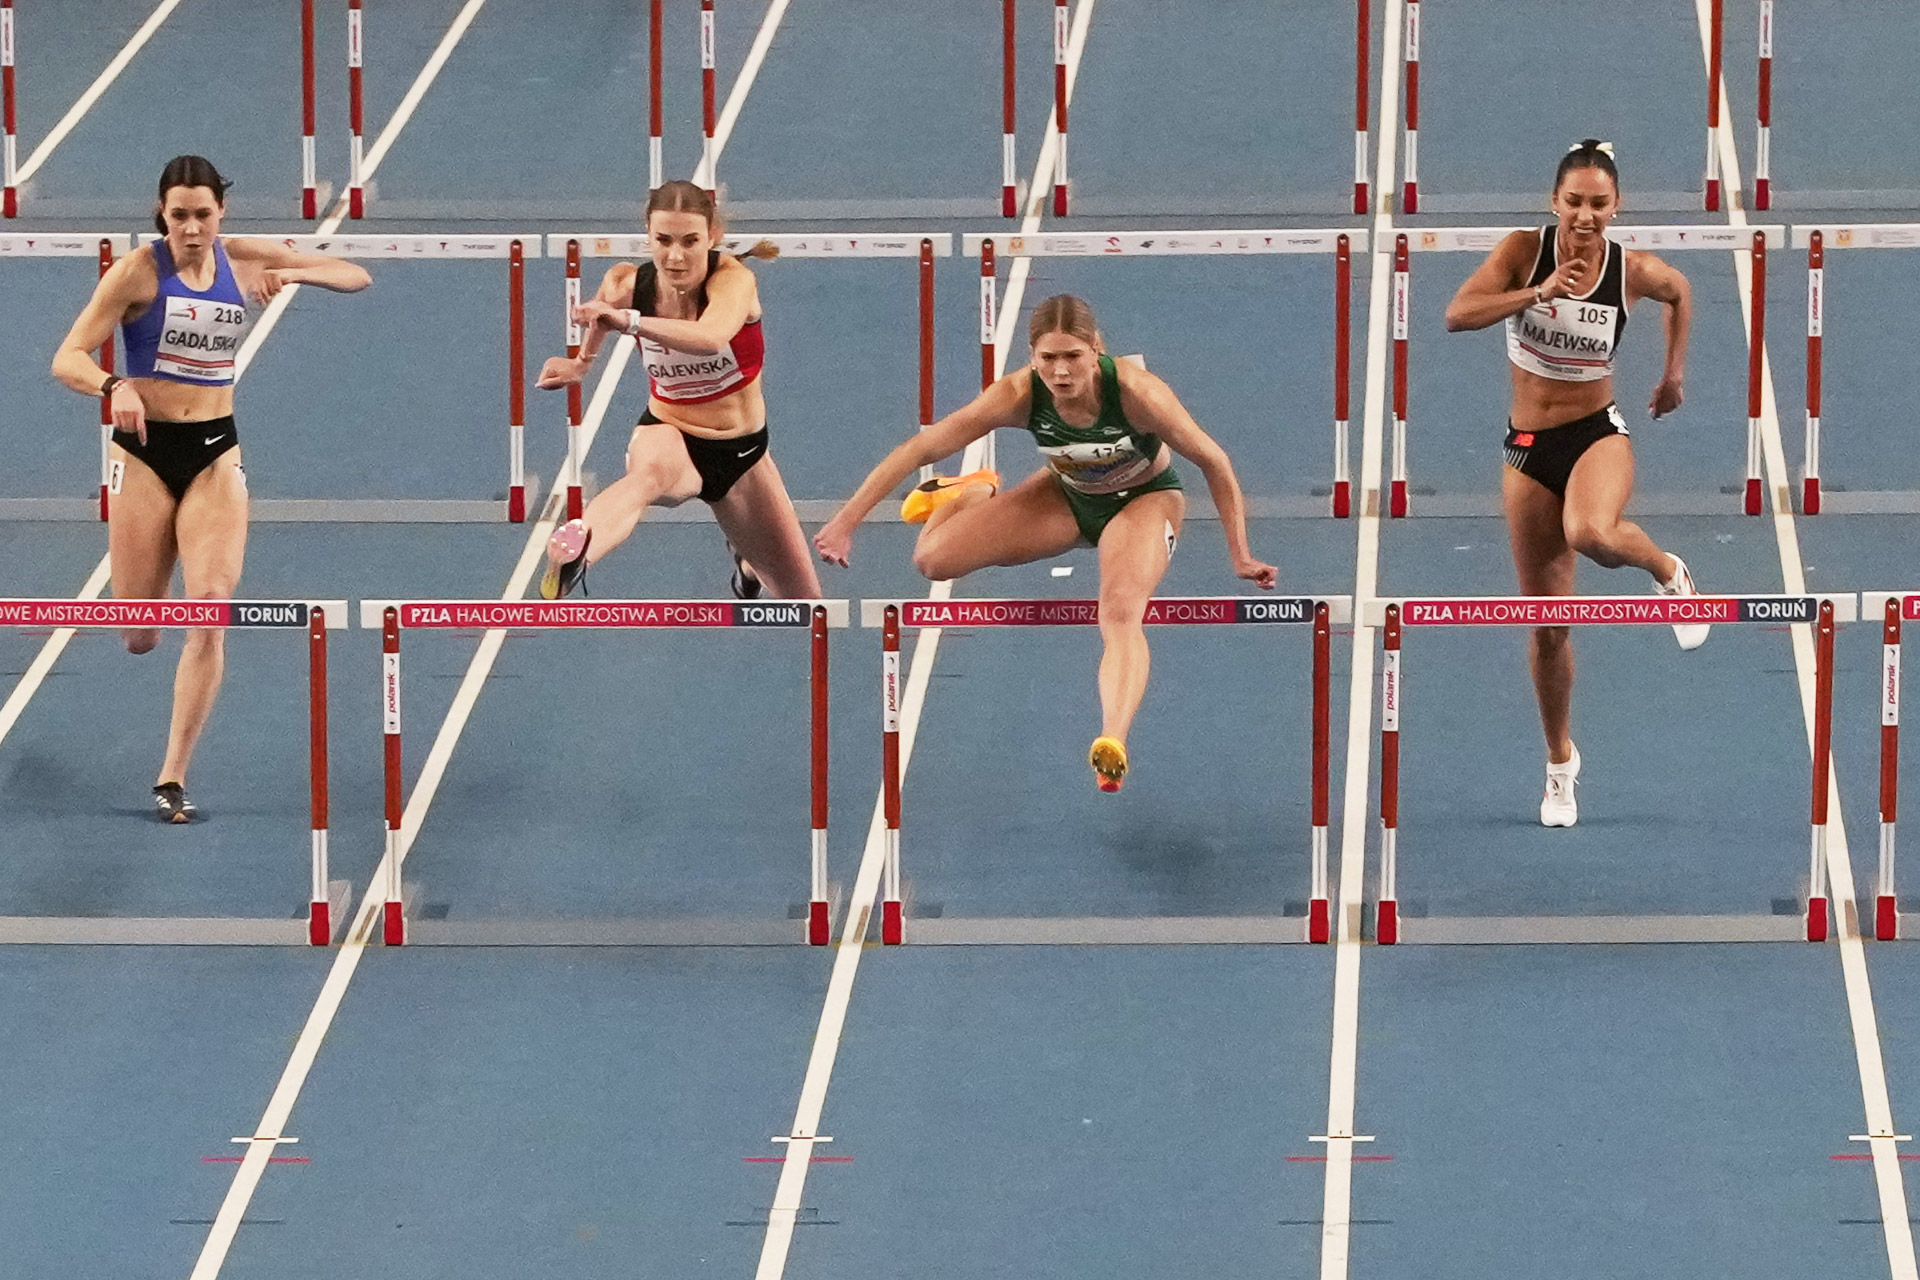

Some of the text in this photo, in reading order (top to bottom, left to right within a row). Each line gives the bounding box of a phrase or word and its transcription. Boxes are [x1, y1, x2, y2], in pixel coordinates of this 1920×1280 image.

[214, 307, 242, 325] 218
[1577, 306, 1608, 325] 105
[1523, 322, 1608, 353] MAJEWSKA
[648, 356, 732, 378] GAJEWSKA
[111, 463, 119, 490] 6
[0, 604, 297, 622] WE MISTRZOSTWA POLSKI TORUŃ
[411, 603, 800, 622] PZLA HALOWE MISTRZOSTWA POLSKI TORUŃ
[912, 600, 1302, 621] PZLA HALOWE MISTRZA POLSKI TORUŃ
[1412, 599, 1806, 620] PZLA HALOWE MISTRZOSTWA POLSKI TORUŃ
[387, 673, 397, 713] polanik
[887, 672, 897, 712] polanik
[1386, 670, 1395, 711] polanik
[1888, 665, 1896, 705] polanik
